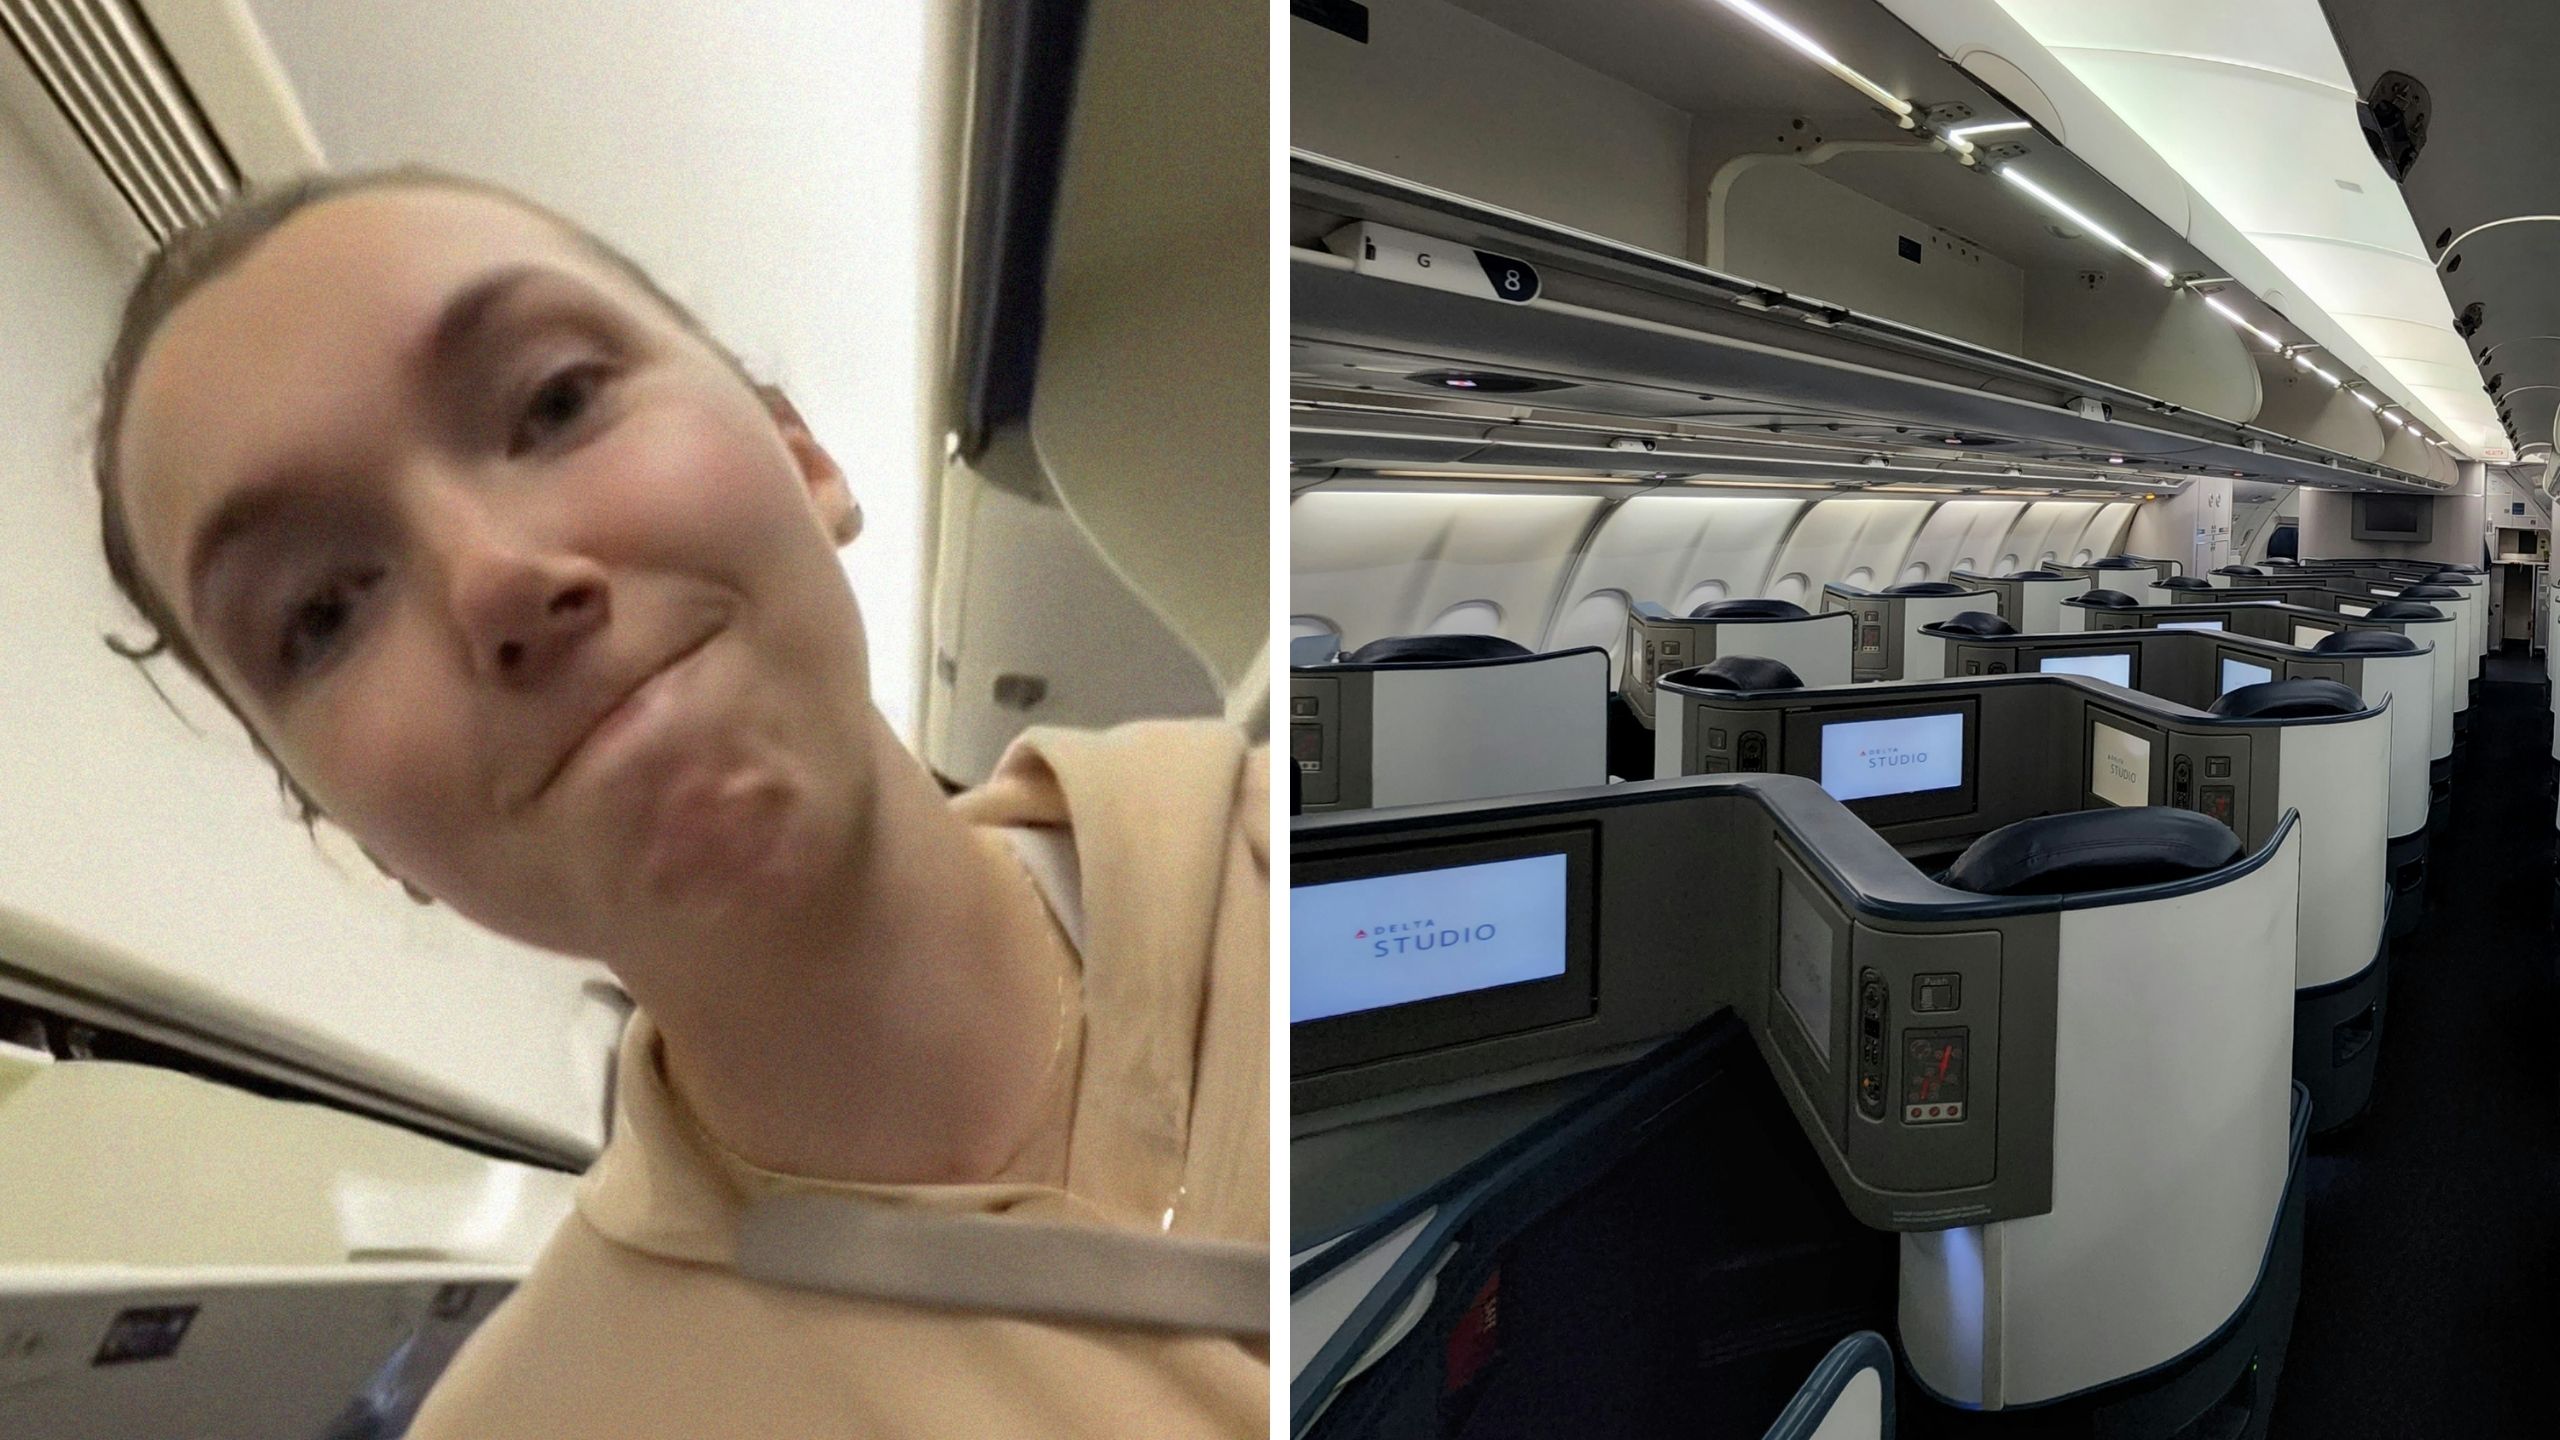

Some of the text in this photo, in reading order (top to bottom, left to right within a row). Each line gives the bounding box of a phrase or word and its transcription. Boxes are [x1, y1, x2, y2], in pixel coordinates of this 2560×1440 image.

[1417, 253, 1521, 291] G 8
[1868, 752, 1928, 769] STUDIO
[2111, 763, 2137, 783] STUDIO
[1374, 919, 1435, 935] DELTA
[1374, 923, 1496, 958] STUDIO
